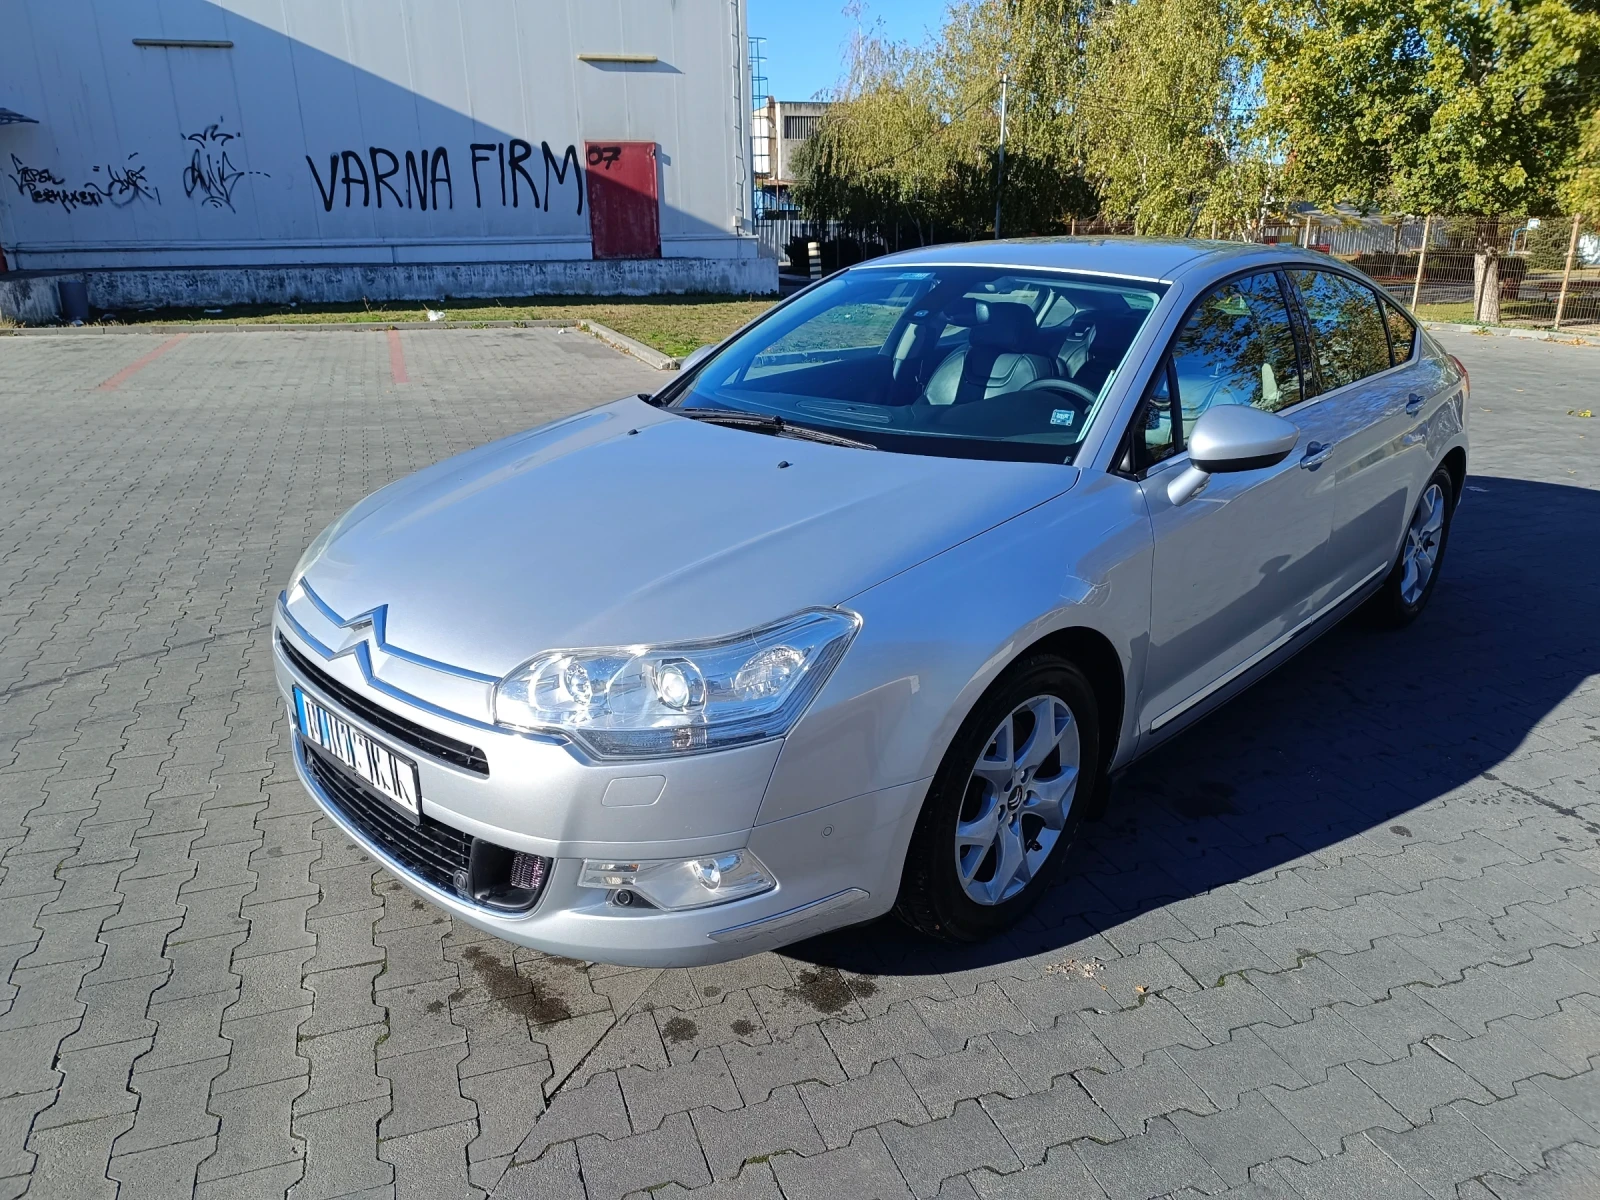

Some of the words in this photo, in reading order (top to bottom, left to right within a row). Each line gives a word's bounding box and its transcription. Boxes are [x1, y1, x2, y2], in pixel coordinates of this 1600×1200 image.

[305, 146, 453, 212] VARNA
[469, 138, 585, 215] FIRM
[586, 145, 622, 171] 07
